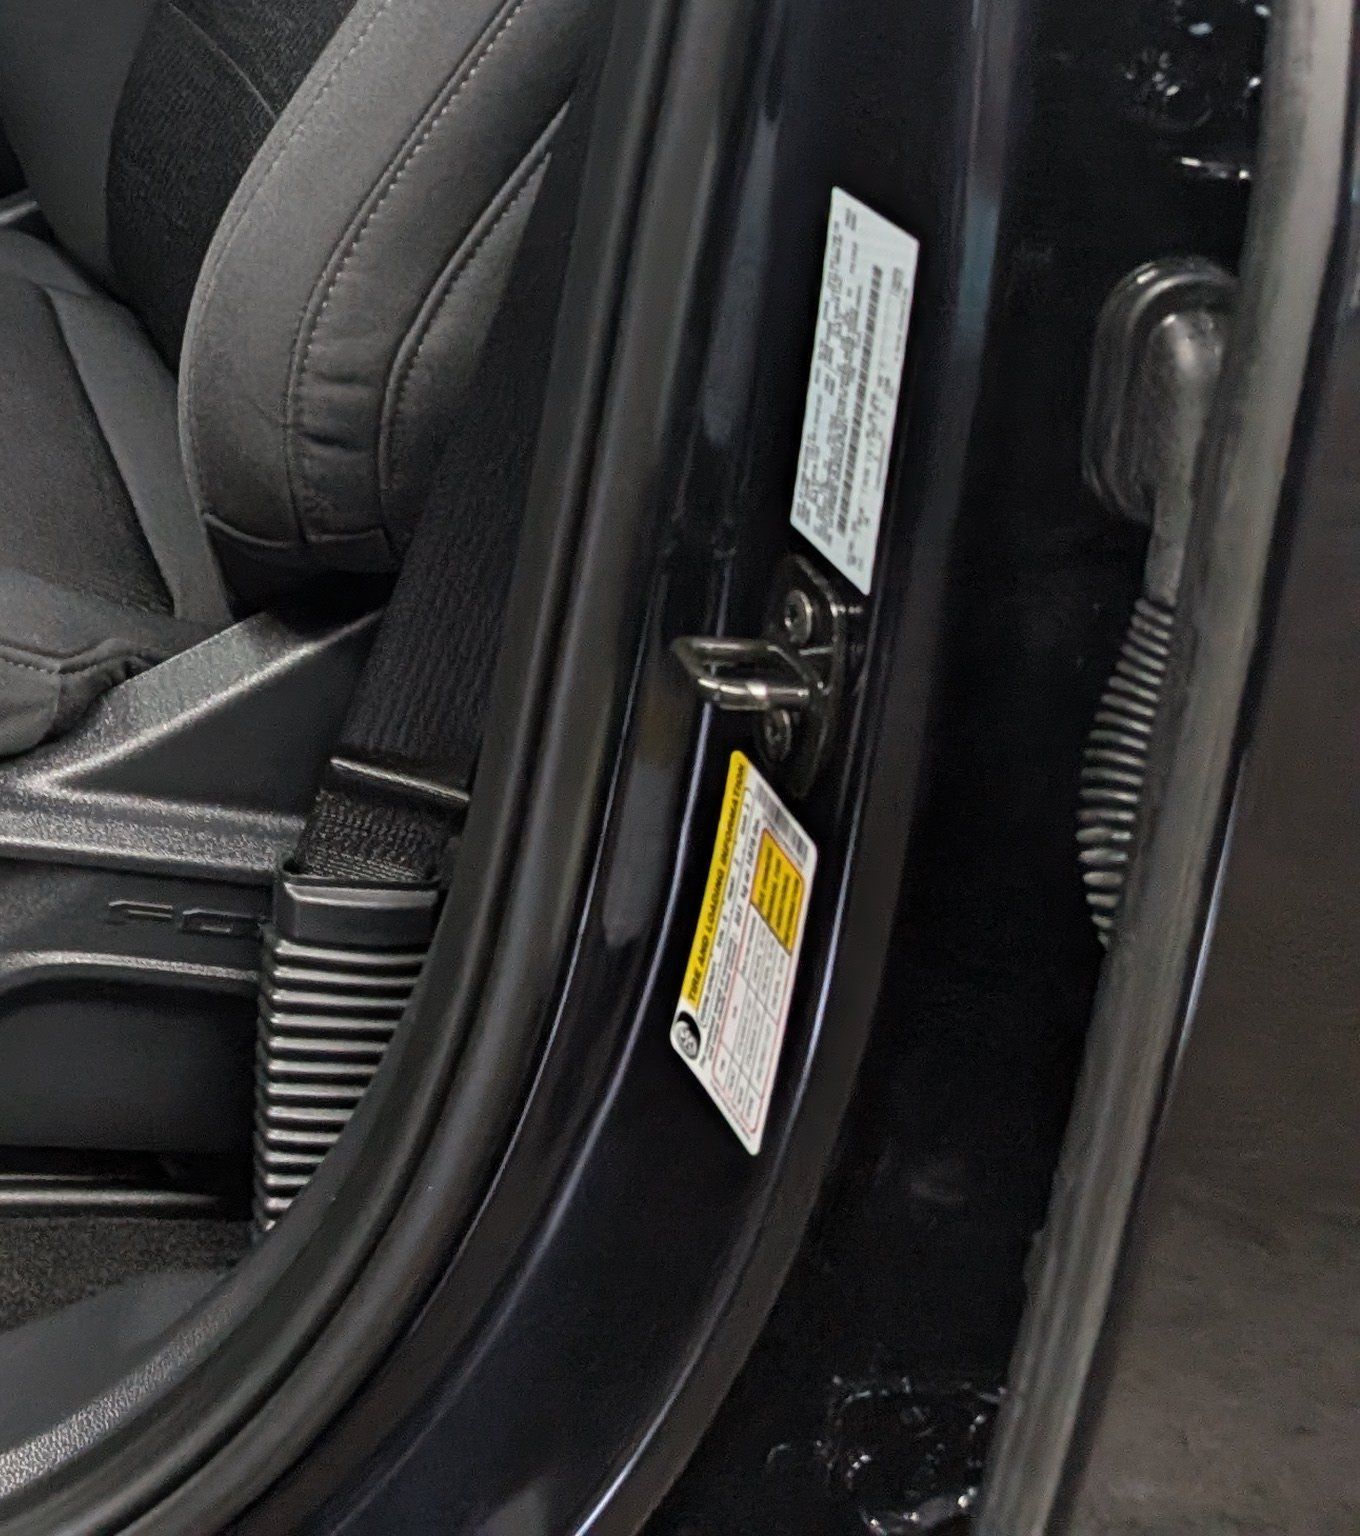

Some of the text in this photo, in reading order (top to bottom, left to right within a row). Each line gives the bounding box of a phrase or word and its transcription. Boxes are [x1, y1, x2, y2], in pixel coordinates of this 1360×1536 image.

[687, 966, 701, 1001] TIRE
[697, 935, 709, 966] AND
[705, 868, 725, 933] LOADING
[720, 763, 744, 865] INFORMATION
